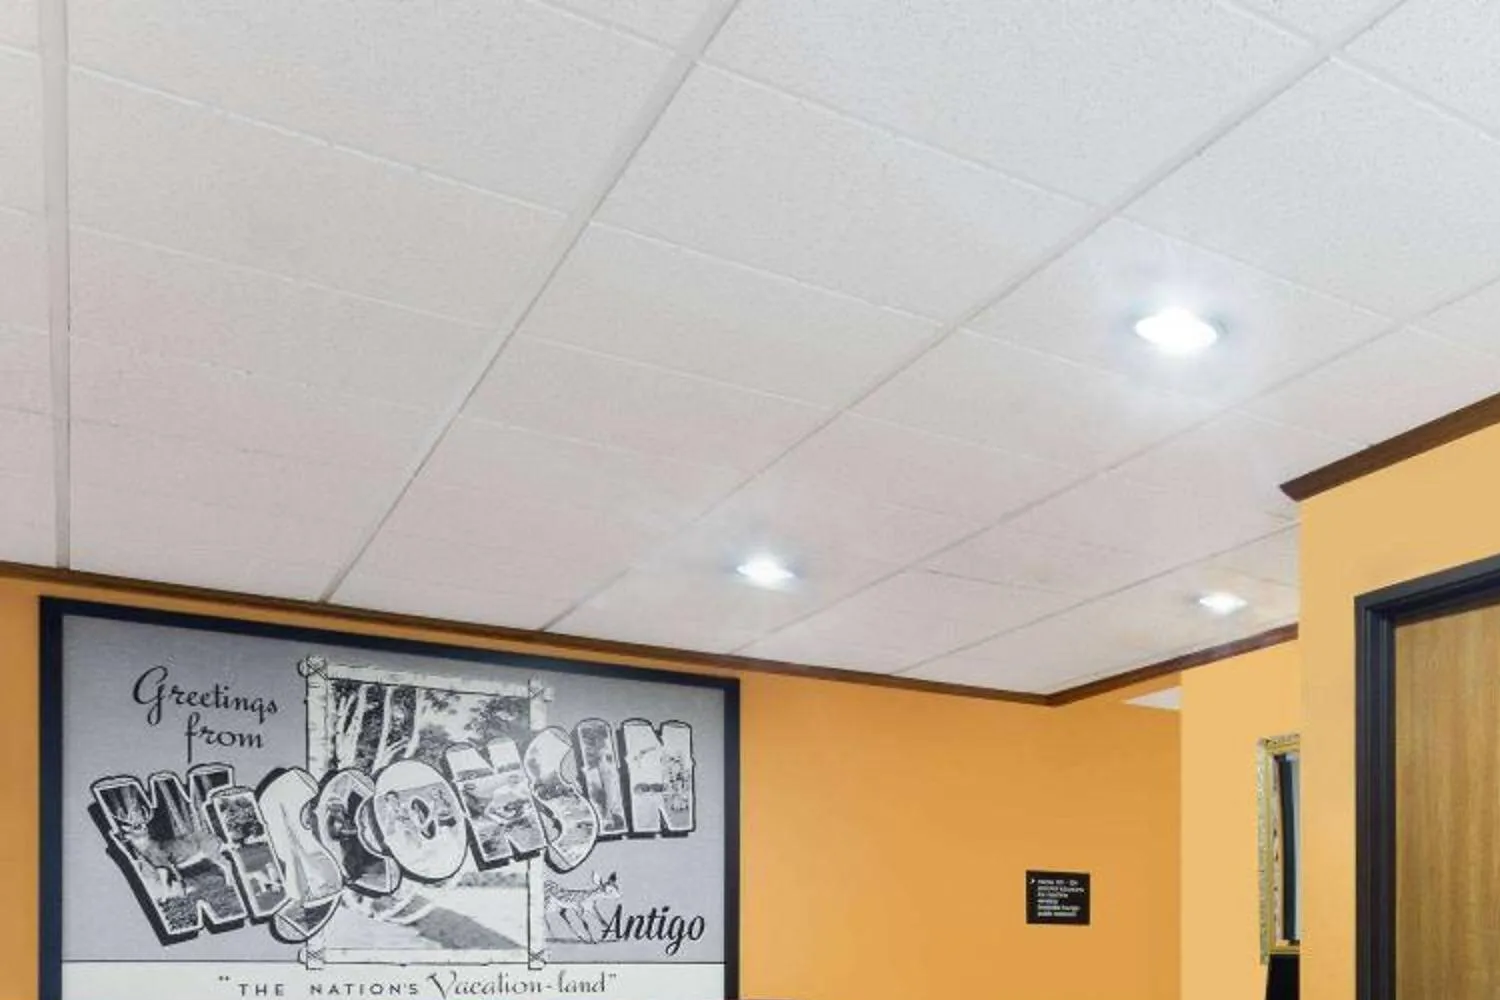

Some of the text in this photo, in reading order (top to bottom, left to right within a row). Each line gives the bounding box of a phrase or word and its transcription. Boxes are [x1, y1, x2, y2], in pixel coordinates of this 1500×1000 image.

[132, 665, 278, 726] Greetings
[184, 711, 264, 764] from
[89, 716, 697, 945] WISCONSIN
[601, 903, 706, 957] Antigo
[309, 983, 420, 997] NATION'S
